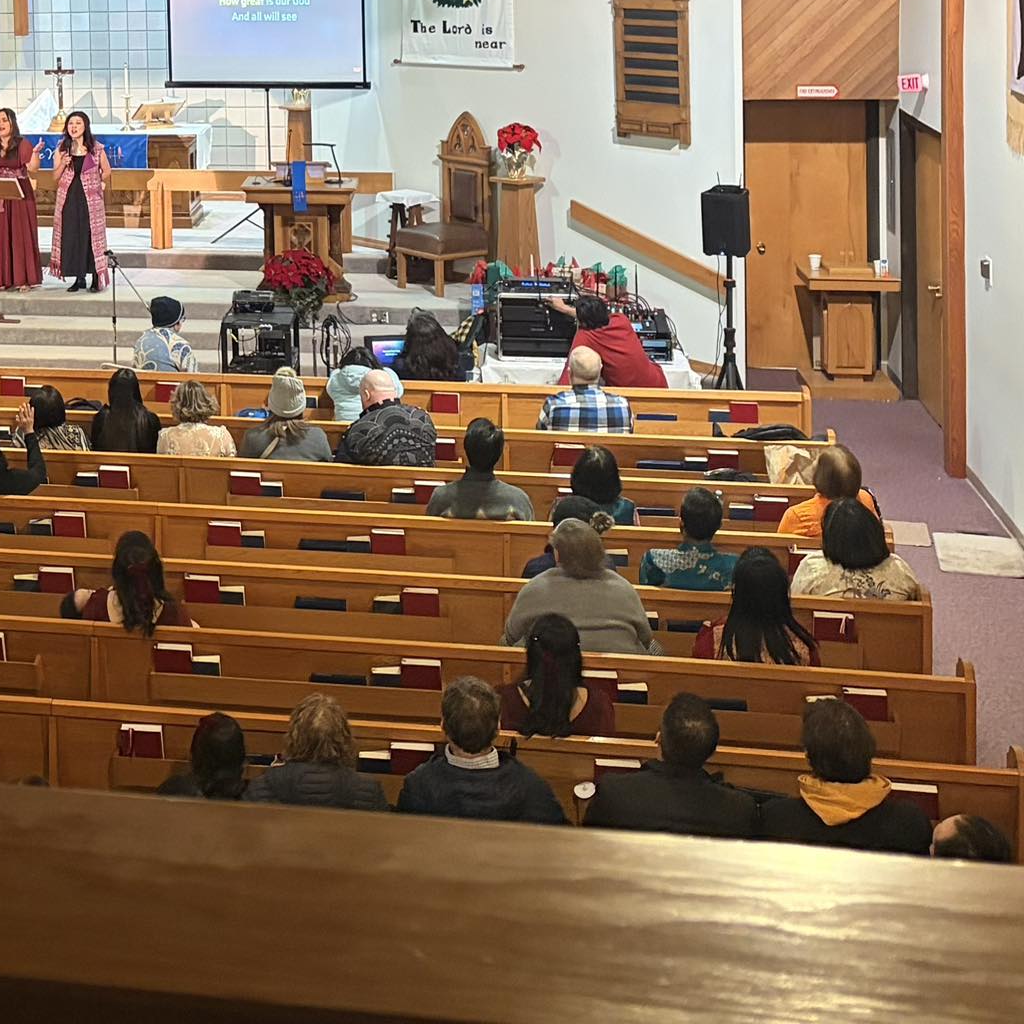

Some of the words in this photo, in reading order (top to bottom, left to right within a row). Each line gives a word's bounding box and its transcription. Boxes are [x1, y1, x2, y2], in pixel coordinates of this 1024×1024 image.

[231, 11, 250, 22] And
[251, 11, 262, 22] all
[263, 11, 280, 22] will
[281, 13, 298, 22] see
[410, 19, 436, 34] The
[442, 20, 473, 35] Lord
[481, 23, 493, 36] is
[474, 40, 507, 50] near
[901, 77, 919, 90] EXIT
